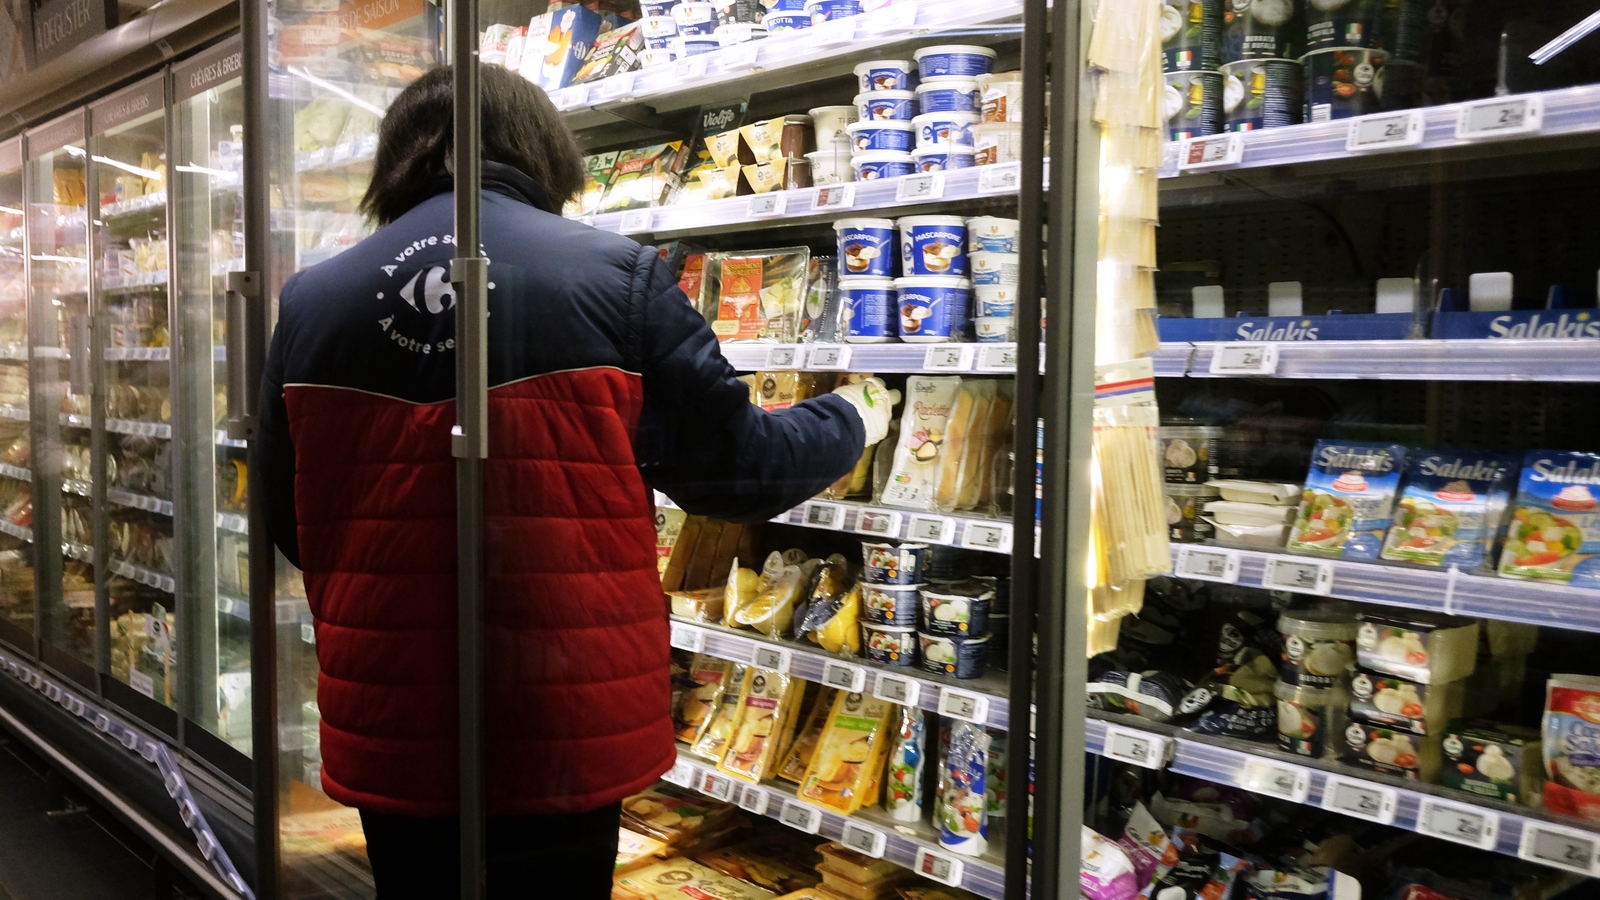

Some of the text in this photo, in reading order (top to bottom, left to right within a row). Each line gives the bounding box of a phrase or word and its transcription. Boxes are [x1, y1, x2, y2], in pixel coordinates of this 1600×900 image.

[222, 52, 242, 75] BREBI
[703, 108, 735, 130] Violife
[840, 233, 881, 244] MASCARPONE
[914, 231, 961, 242] MASCARPONE
[394, 235, 438, 263] votre
[378, 314, 394, 331] À
[390, 330, 431, 354] votre
[1235, 320, 1320, 341] Salakis
[1488, 312, 1600, 339] Salakis
[1317, 446, 1395, 472] Salakis
[1420, 455, 1507, 482] Salakis
